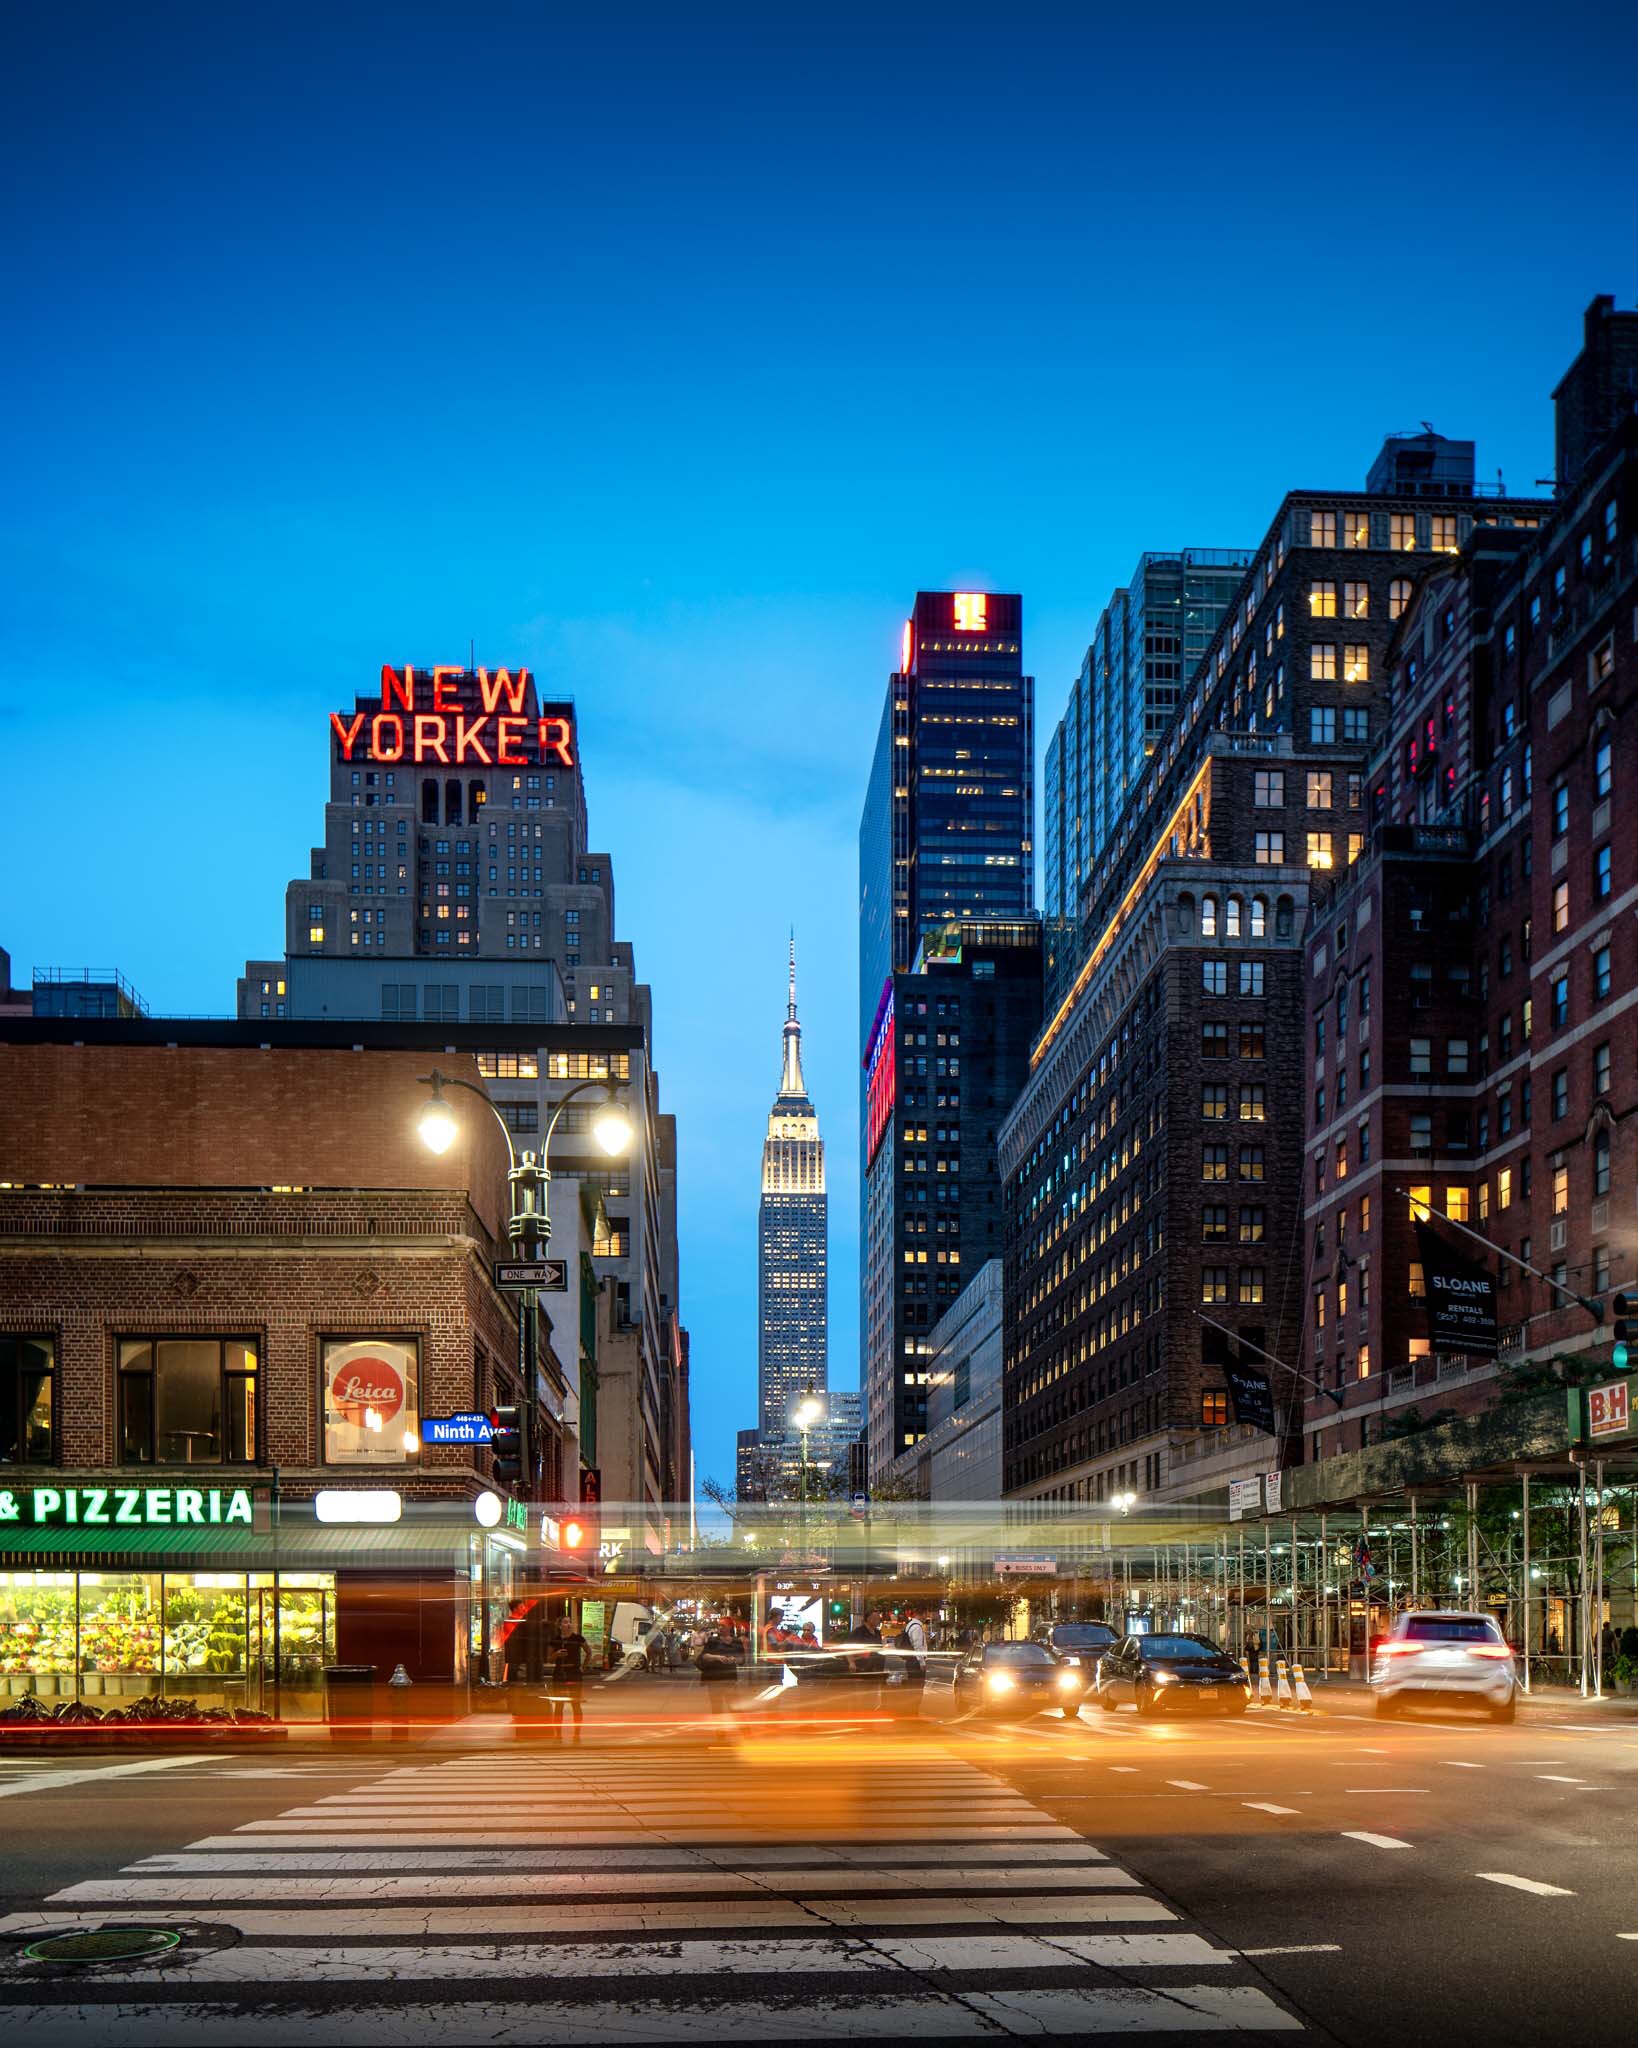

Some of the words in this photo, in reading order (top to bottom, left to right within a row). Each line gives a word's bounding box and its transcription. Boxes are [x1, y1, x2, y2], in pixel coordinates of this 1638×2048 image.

[381, 664, 528, 713] NEW
[329, 712, 573, 766] YORKER
[506, 1270, 525, 1279] ONE
[533, 1270, 554, 1279] WAY
[1432, 1276, 1491, 1293] SLOANE
[1447, 1304, 1483, 1315] RENTALS
[336, 1376, 397, 1401] Leica
[1231, 1374, 1267, 1390] SANE
[1590, 1387, 1625, 1424] B&H
[434, 1424, 475, 1439] Ninth
[0, 1490, 20, 1521] &
[34, 1488, 253, 1523] PIZZERIA
